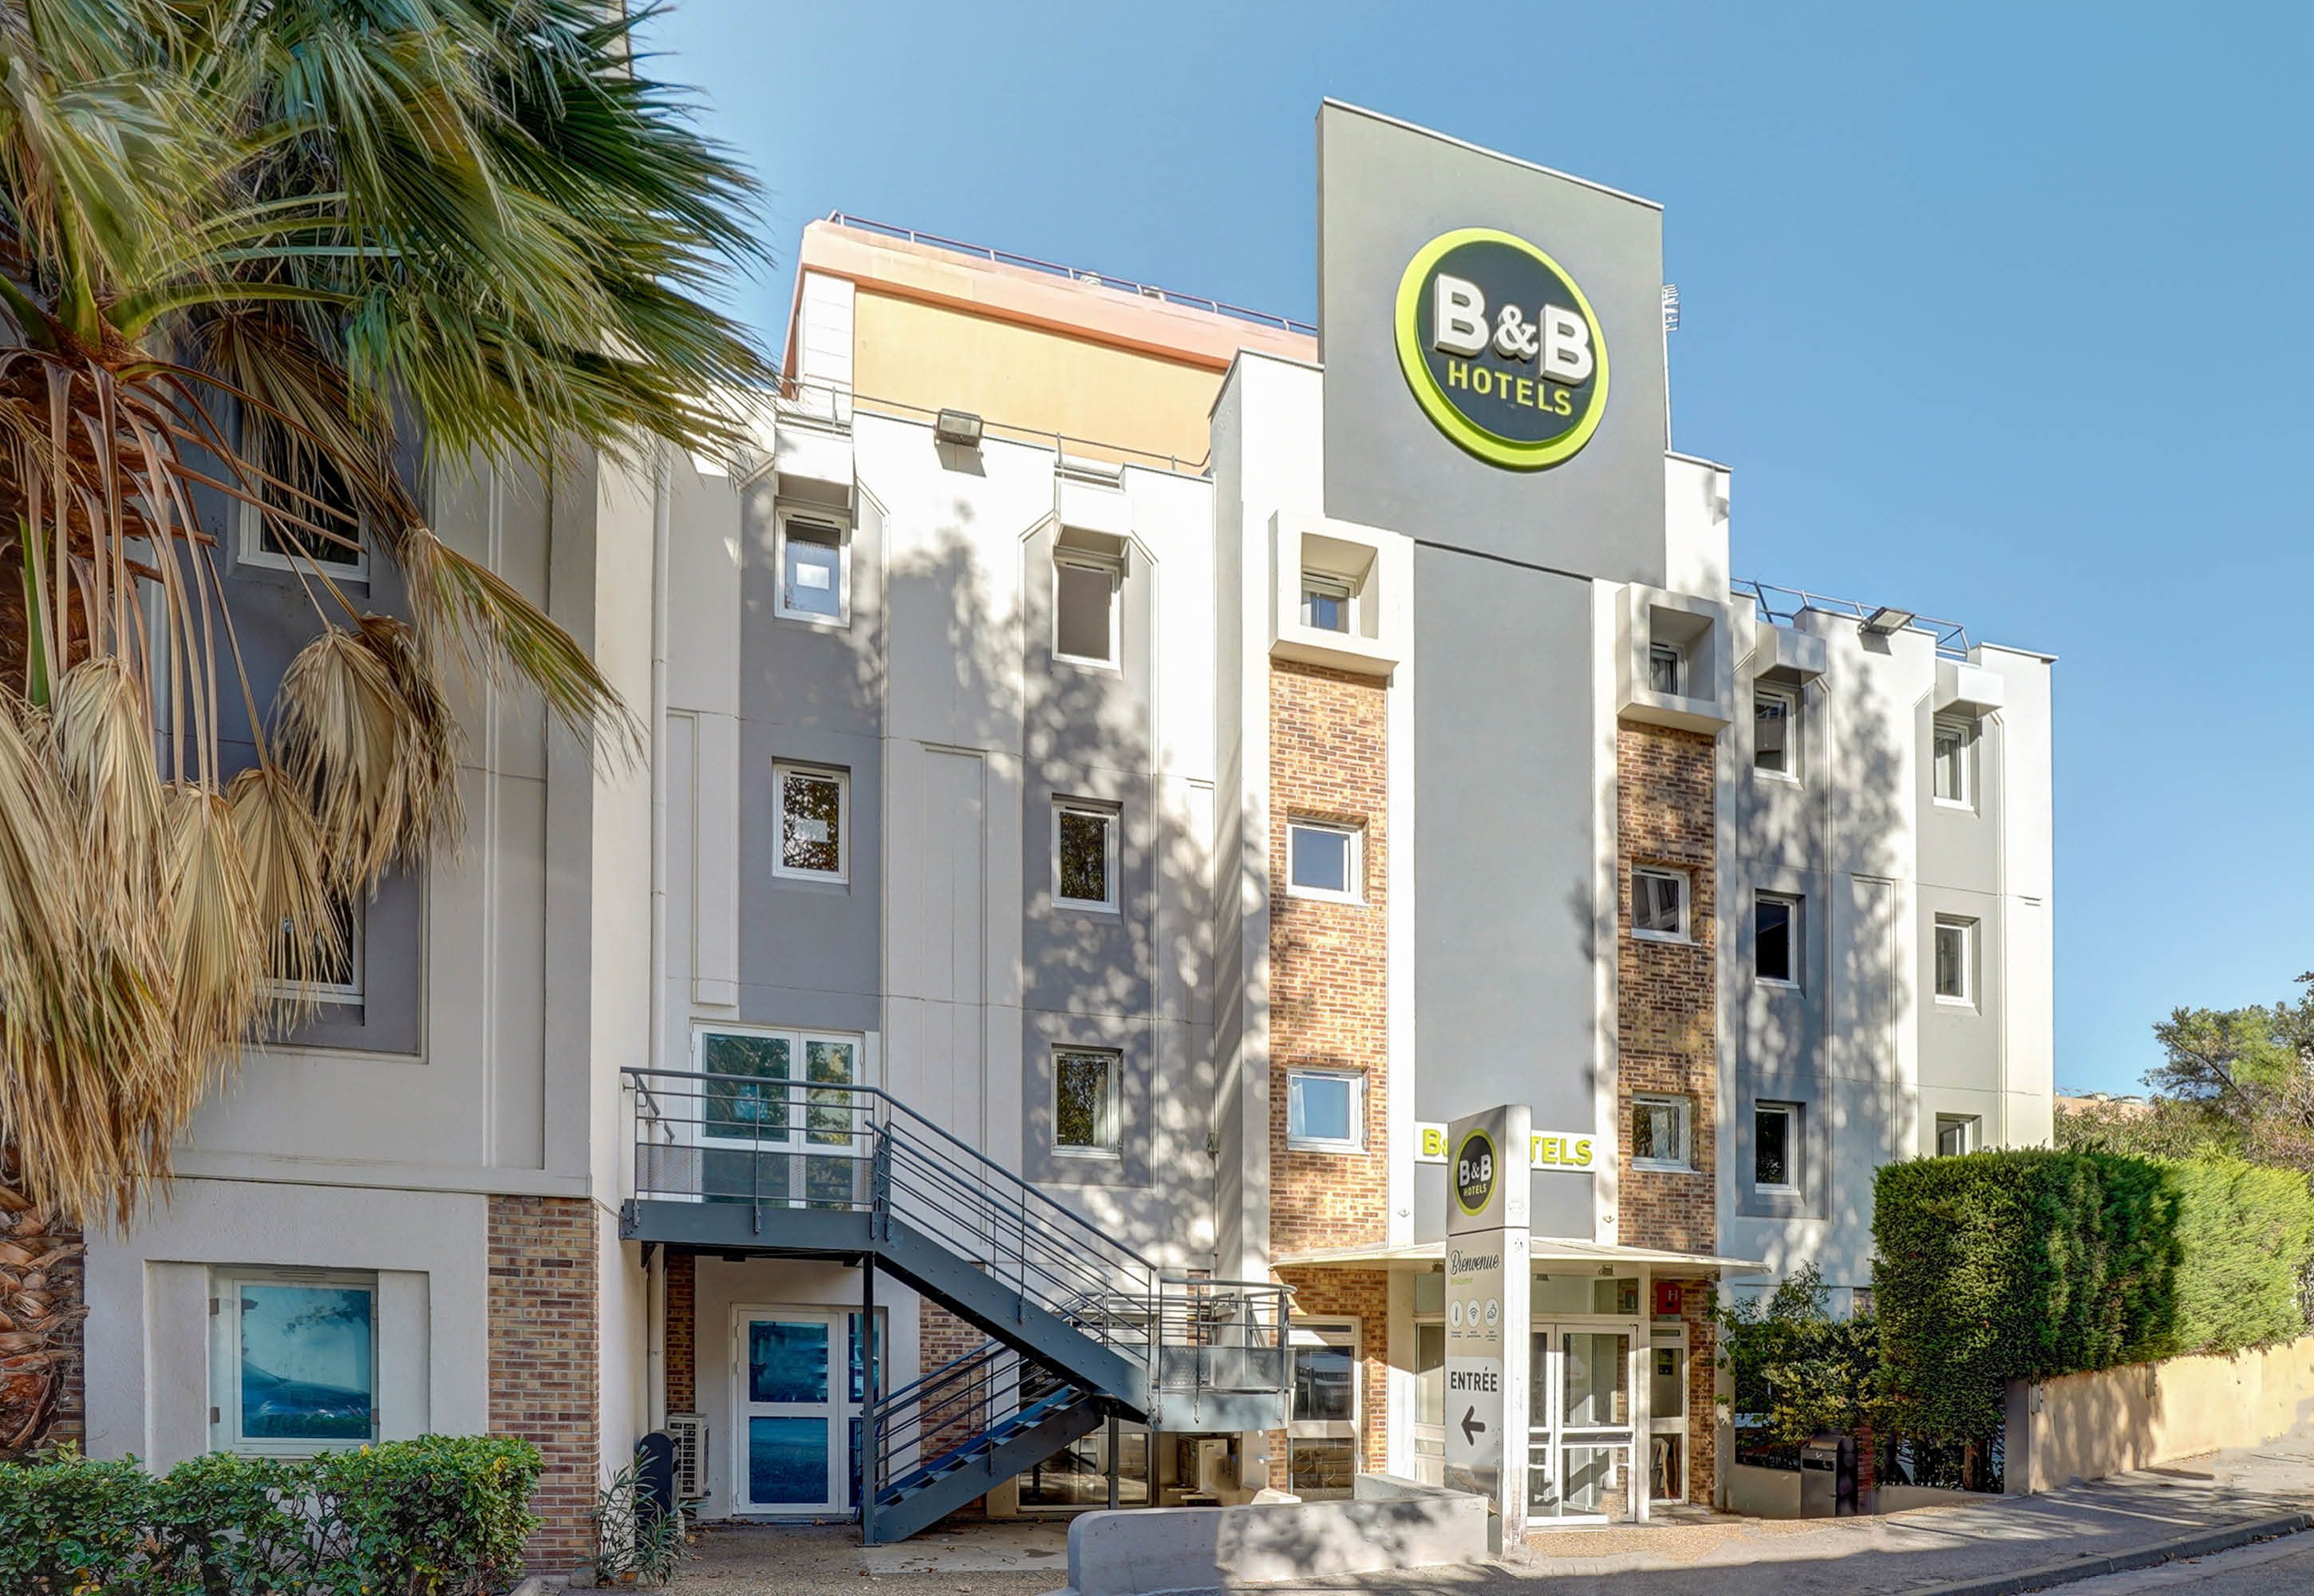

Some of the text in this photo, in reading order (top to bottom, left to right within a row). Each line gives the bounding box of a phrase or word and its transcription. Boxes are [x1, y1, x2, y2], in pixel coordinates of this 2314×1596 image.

[1434, 273, 1593, 386] B&B
[1447, 360, 1572, 417] HOTELS
[1459, 1154, 1492, 1187] B&B
[1463, 1183, 1487, 1197] HOTELS
[1450, 1250, 1500, 1275] Bienvenue
[1450, 1366, 1498, 1393] ENTRÉE
